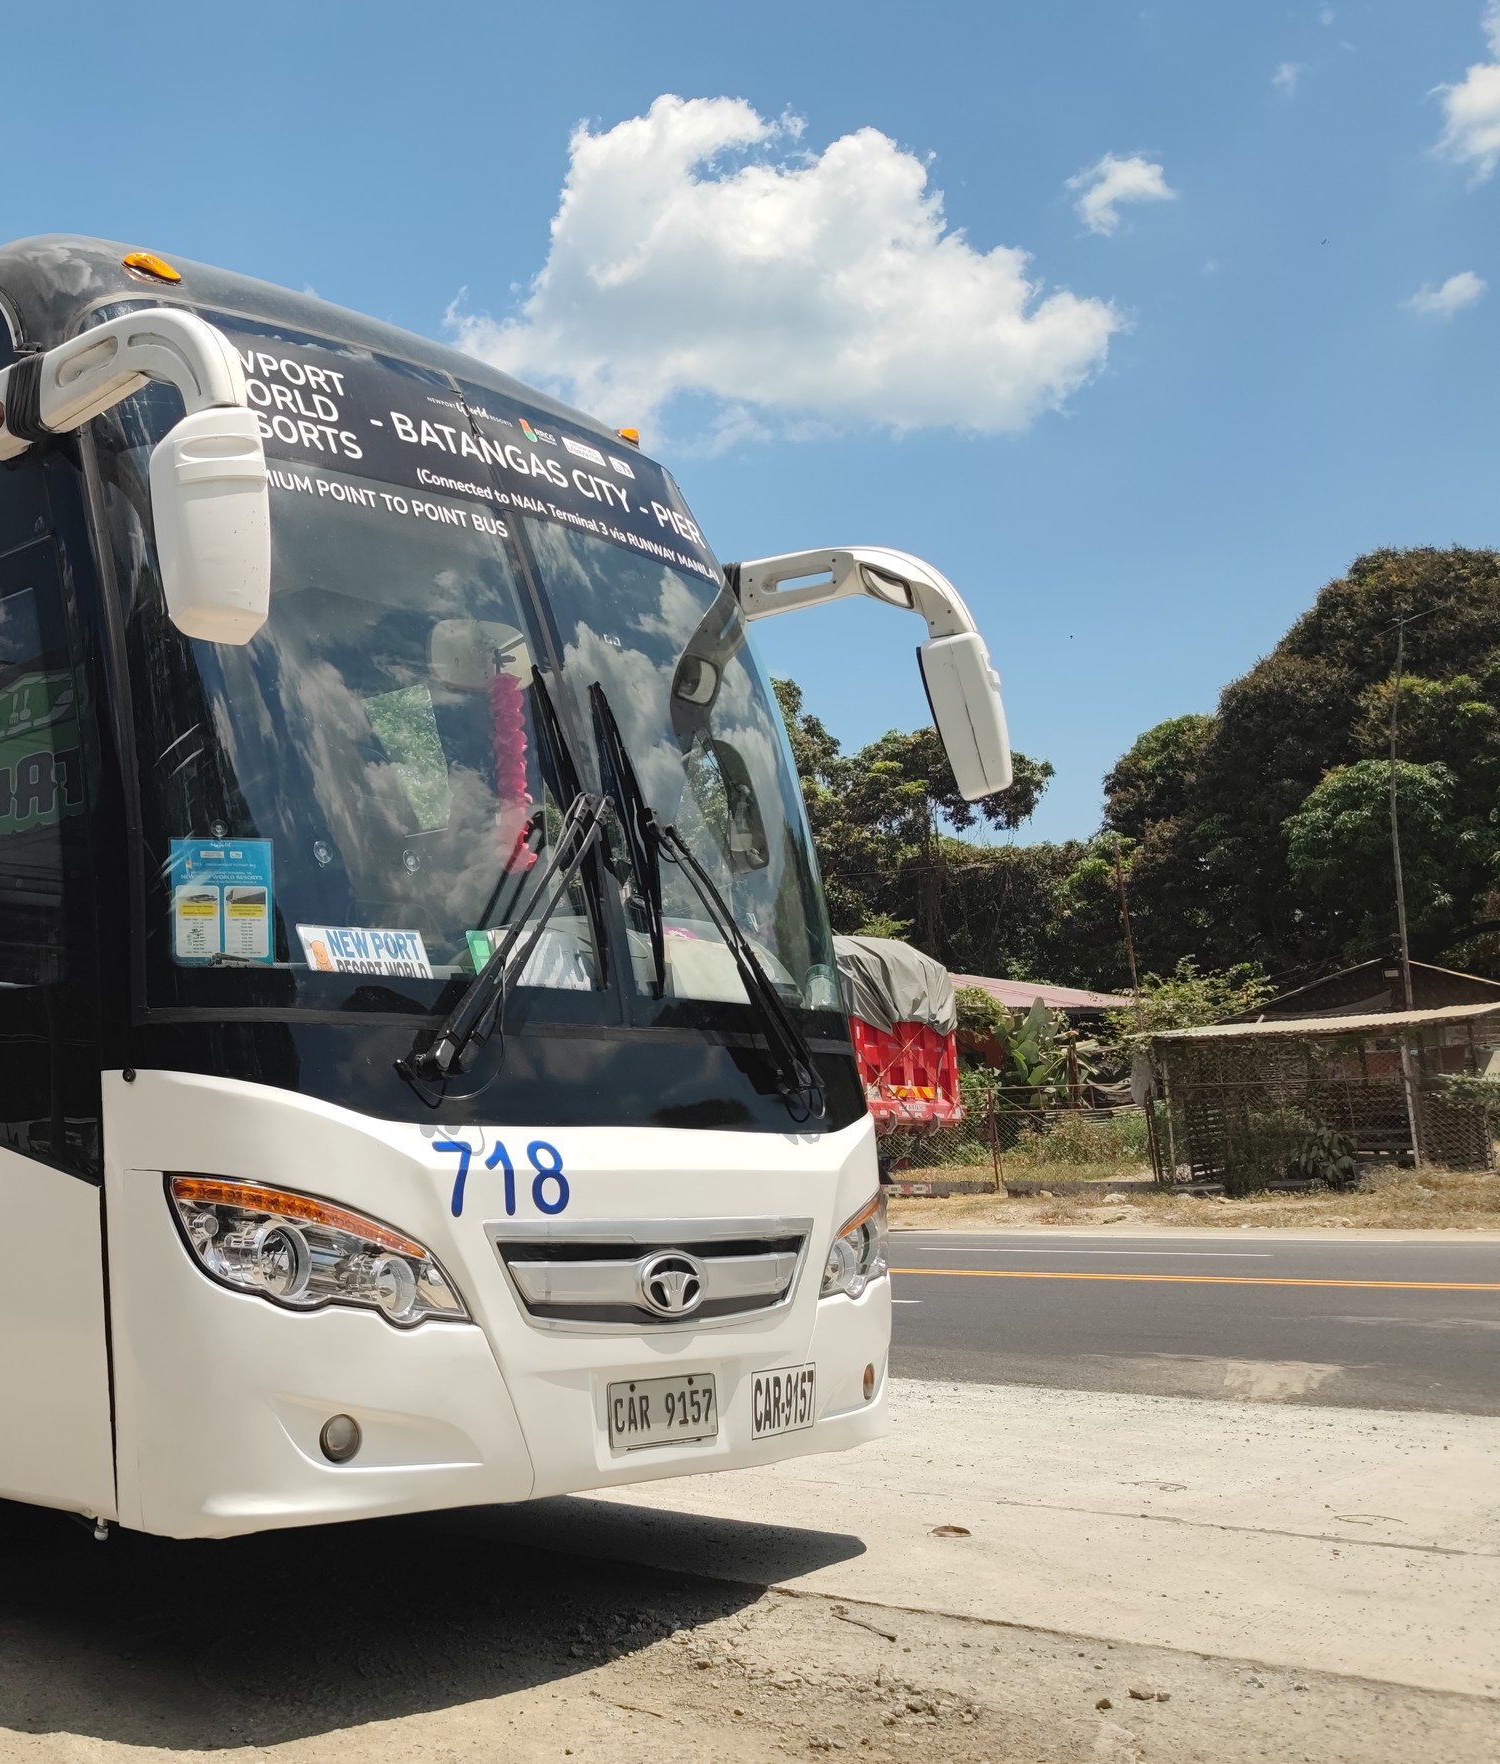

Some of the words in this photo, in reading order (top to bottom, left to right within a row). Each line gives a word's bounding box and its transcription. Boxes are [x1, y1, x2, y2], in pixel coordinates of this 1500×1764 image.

[245, 378, 339, 422] ORLD
[253, 410, 363, 460] SORTS
[315, 479, 376, 508] POINT
[380, 493, 408, 515] TO
[411, 500, 467, 529] POINT
[471, 513, 509, 538] BUS
[390, 411, 569, 489] BATANGAS
[572, 469, 630, 513] CITY
[651, 500, 707, 549] PIER
[416, 467, 493, 500] (Connected
[494, 488, 509, 505] to
[512, 492, 548, 515] NAIA
[547, 503, 600, 533] Terminal
[599, 522, 609, 535] 3
[609, 527, 627, 543] via
[626, 532, 677, 563] RUNWAY
[325, 930, 370, 958] NEW
[370, 932, 420, 960] PORT
[432, 1139, 570, 1218] 718
[614, 1396, 650, 1433] CAR
[665, 1388, 714, 1427] 9157
[753, 1370, 814, 1434] CAR-9157
